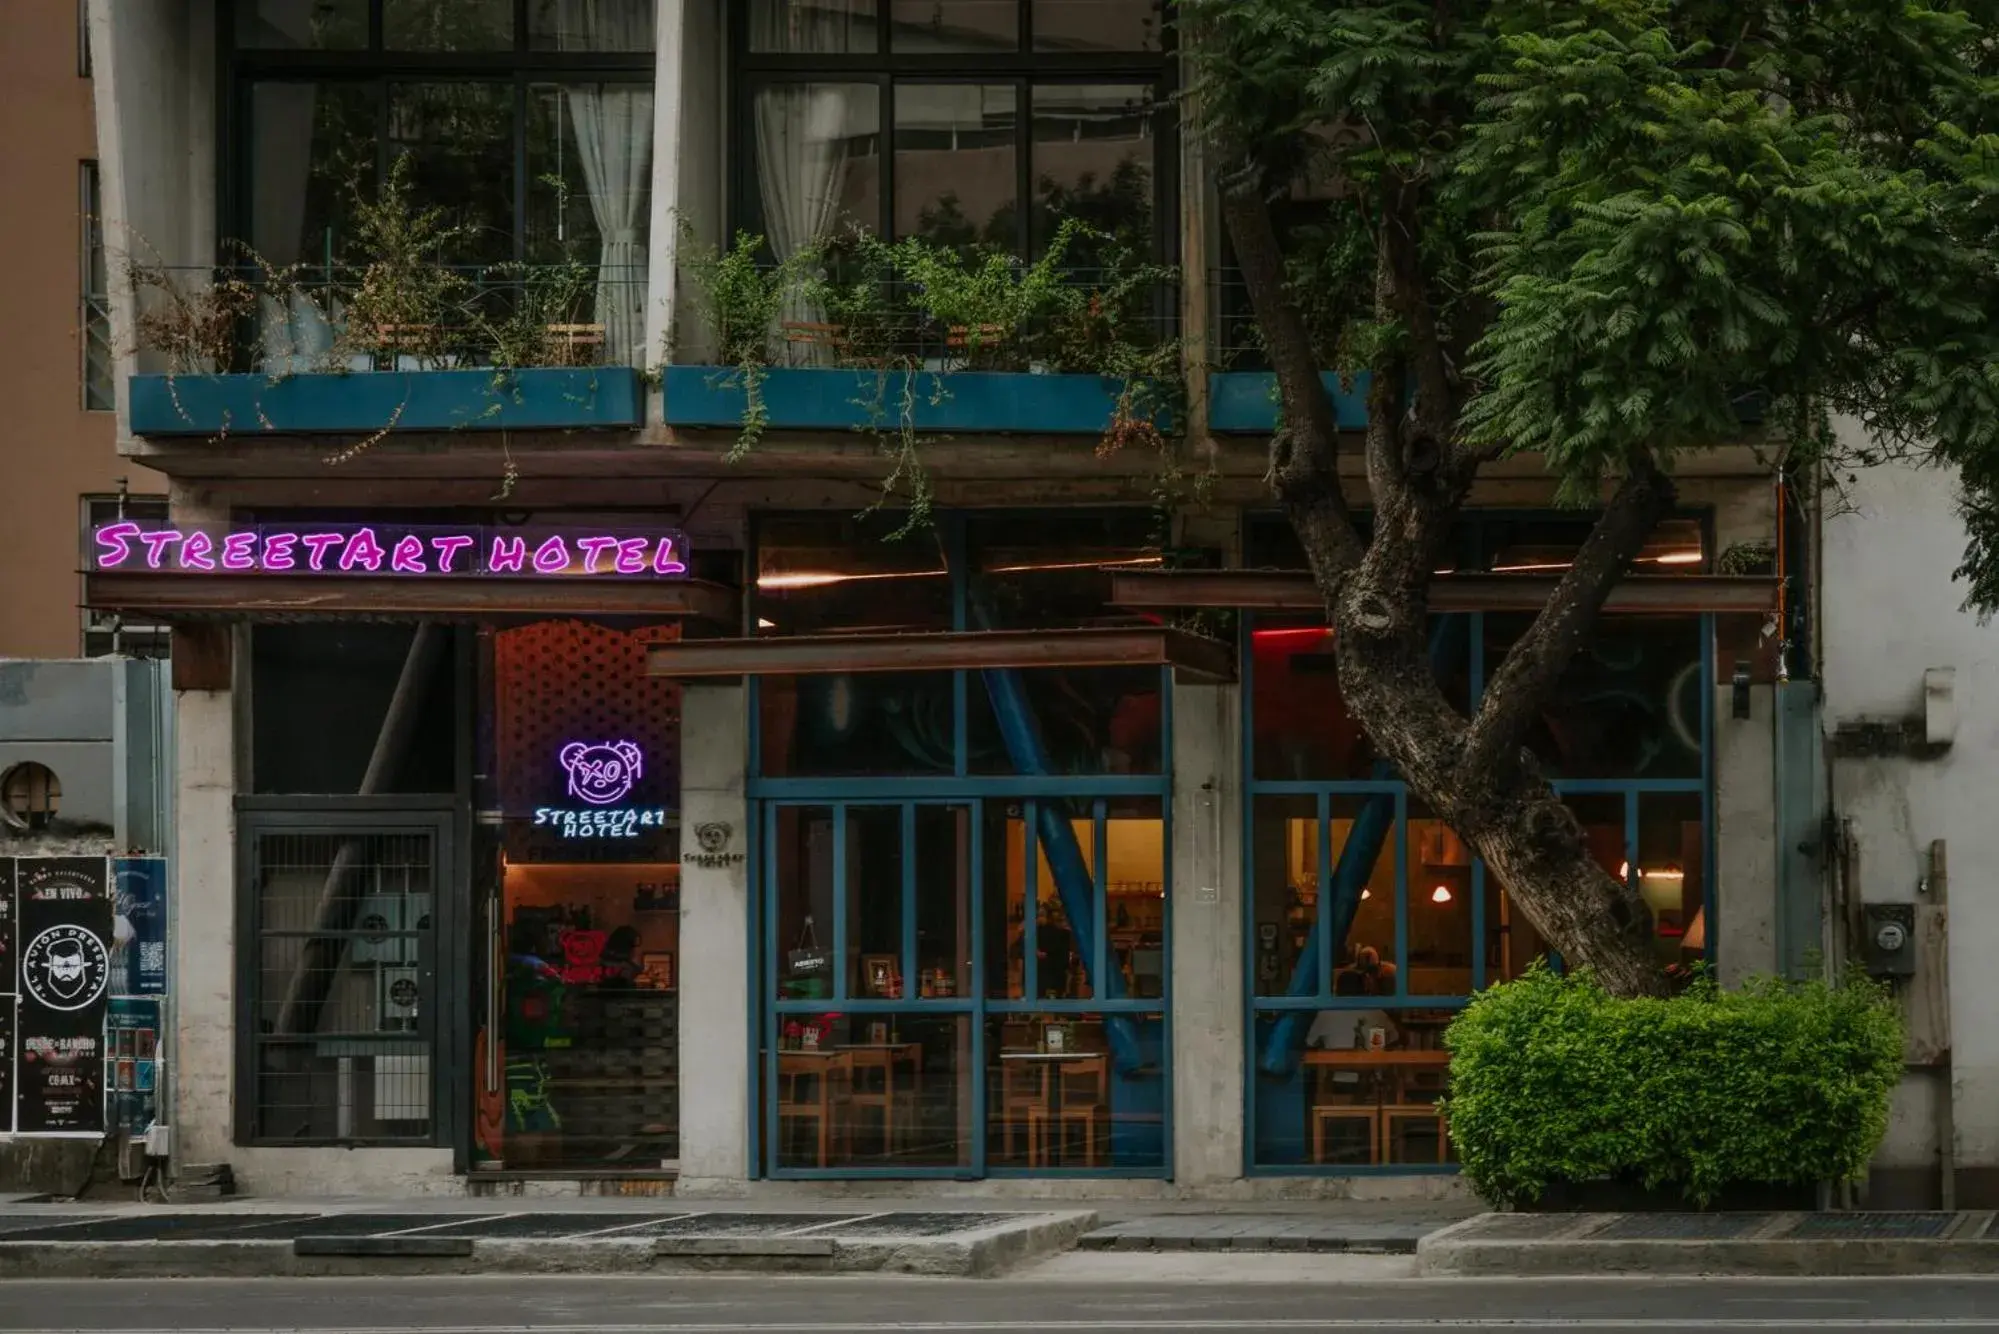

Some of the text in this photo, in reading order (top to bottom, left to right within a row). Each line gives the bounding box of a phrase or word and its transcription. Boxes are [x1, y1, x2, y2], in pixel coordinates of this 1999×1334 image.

[95, 522, 686, 574] STREETART HOTEL
[534, 808, 665, 826] STREETART
[564, 823, 639, 838] HOTEL
